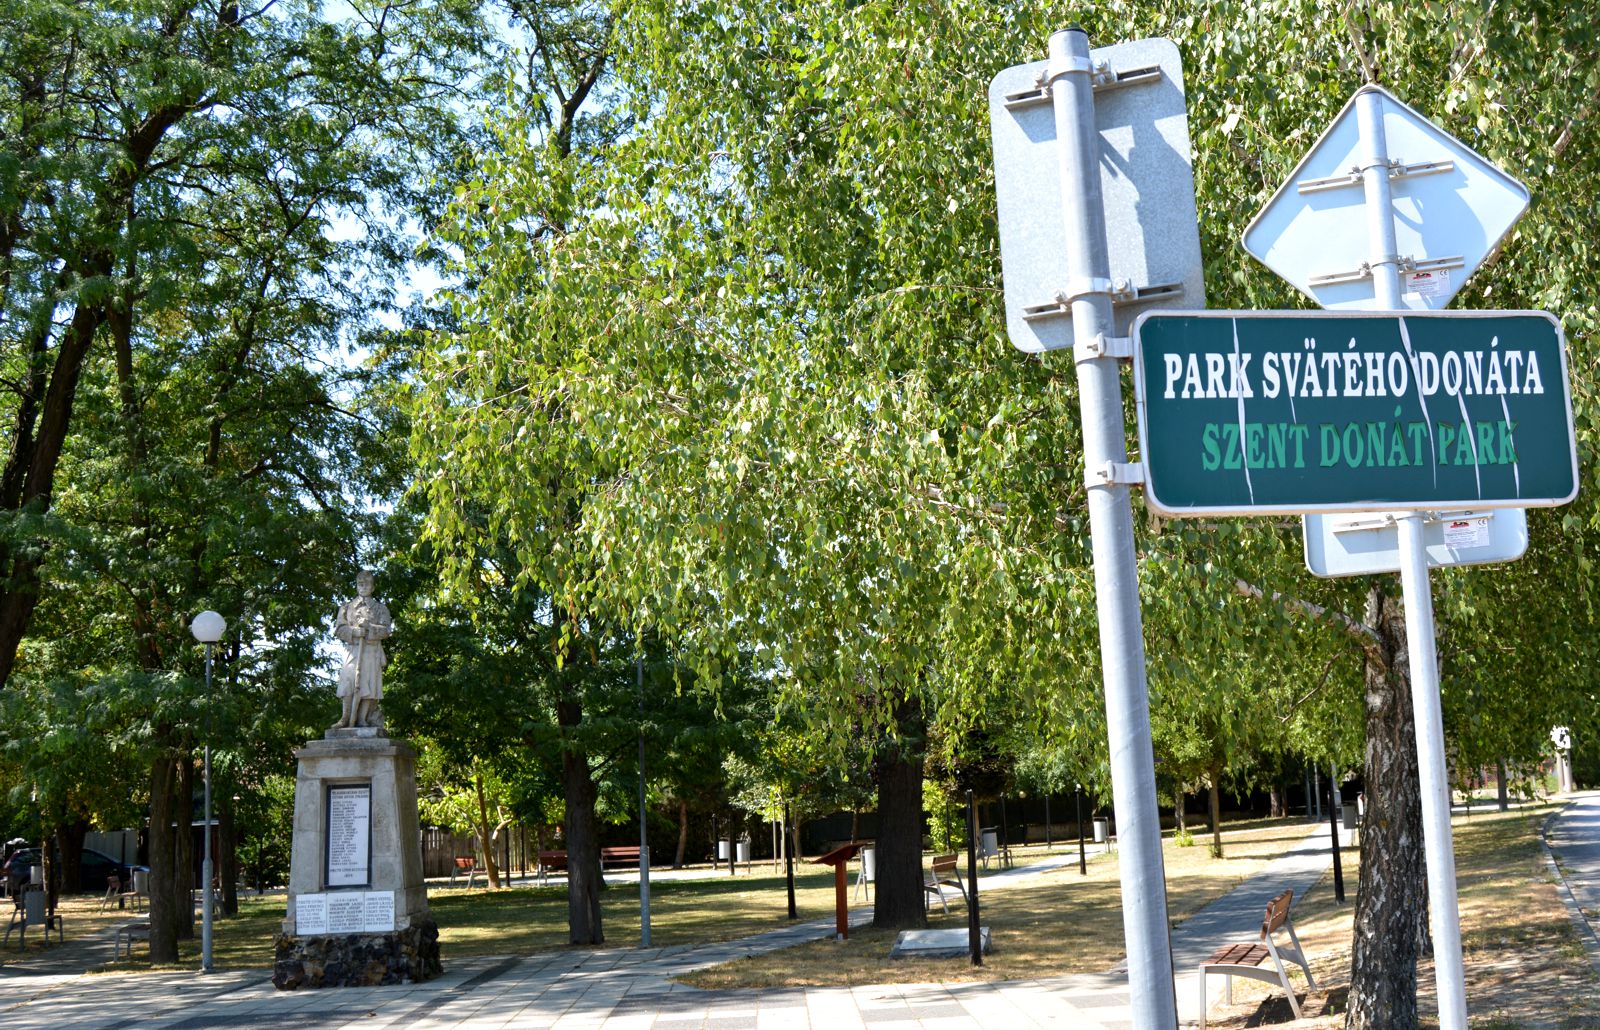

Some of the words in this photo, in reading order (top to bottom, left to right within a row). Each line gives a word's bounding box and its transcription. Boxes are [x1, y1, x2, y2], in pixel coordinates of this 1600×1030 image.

[1163, 353, 1254, 399] PARK
[1262, 337, 1408, 399] SVÄTÉHO
[1419, 336, 1544, 395] DONÁTA
[1201, 422, 1310, 471] SZENT
[1320, 404, 1428, 468] DONÁT
[1438, 421, 1519, 465] PARK
